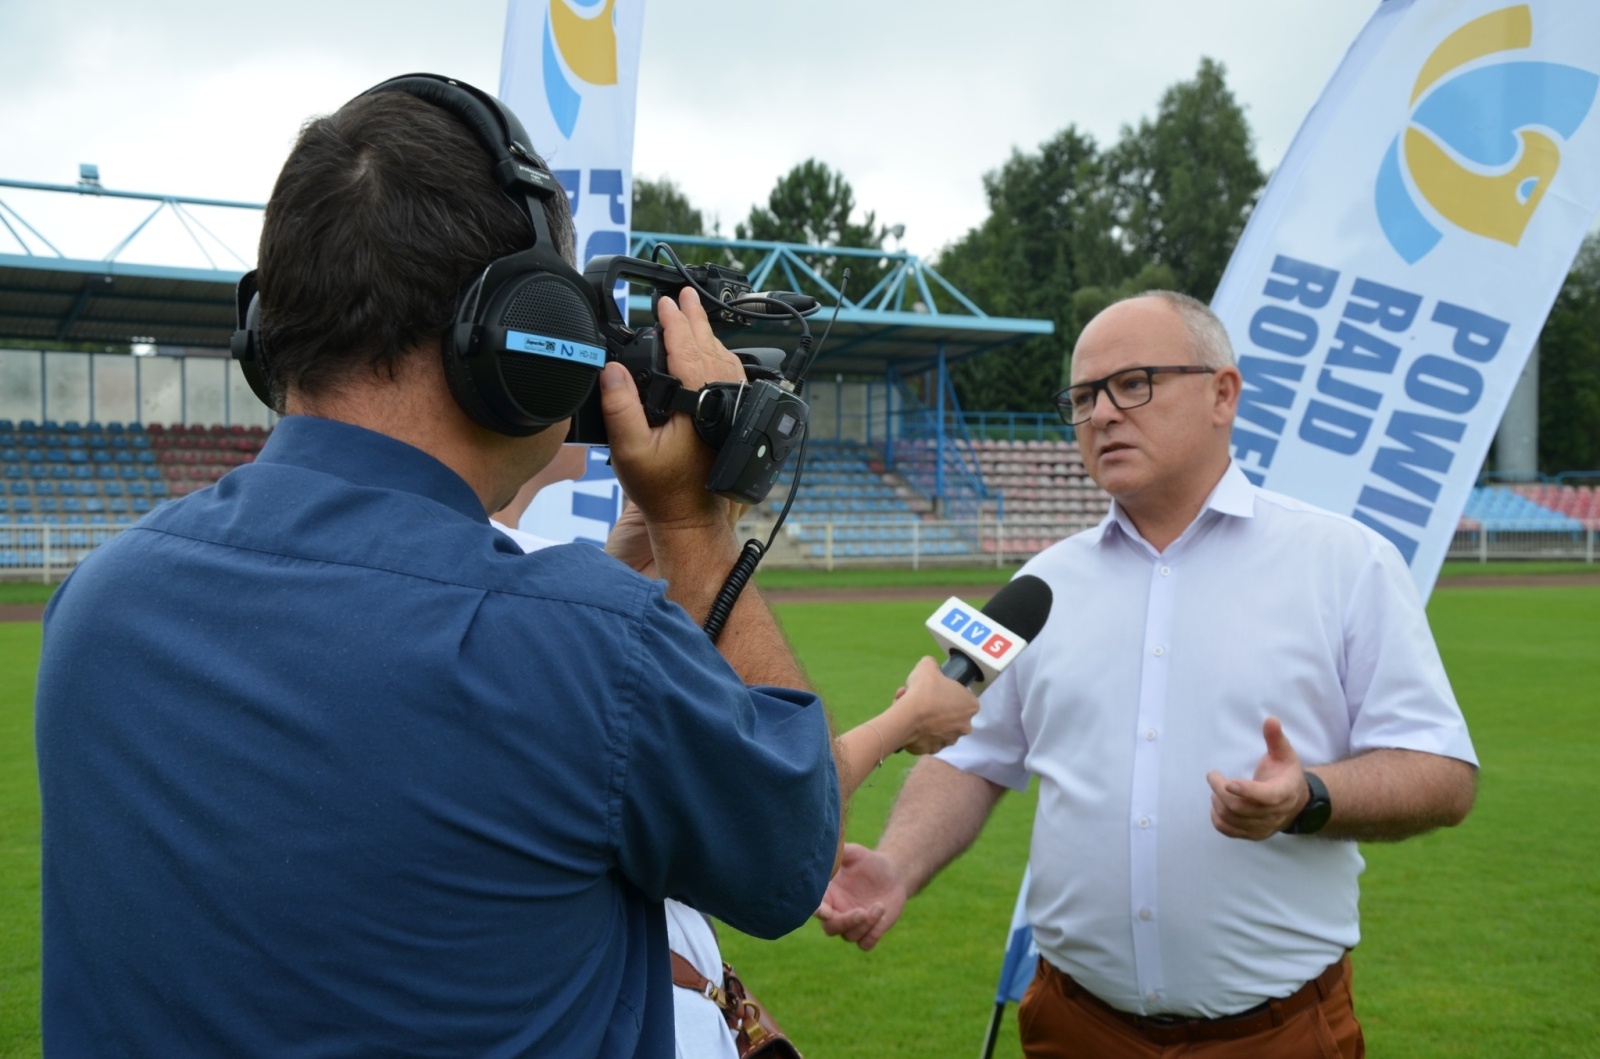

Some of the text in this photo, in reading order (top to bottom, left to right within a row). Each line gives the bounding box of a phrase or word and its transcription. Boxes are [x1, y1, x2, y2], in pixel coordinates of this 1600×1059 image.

[561, 343, 574, 357] 2
[1229, 254, 1341, 488] ROWE
[1298, 277, 1424, 456] RAJD
[948, 612, 1005, 654] TVS
